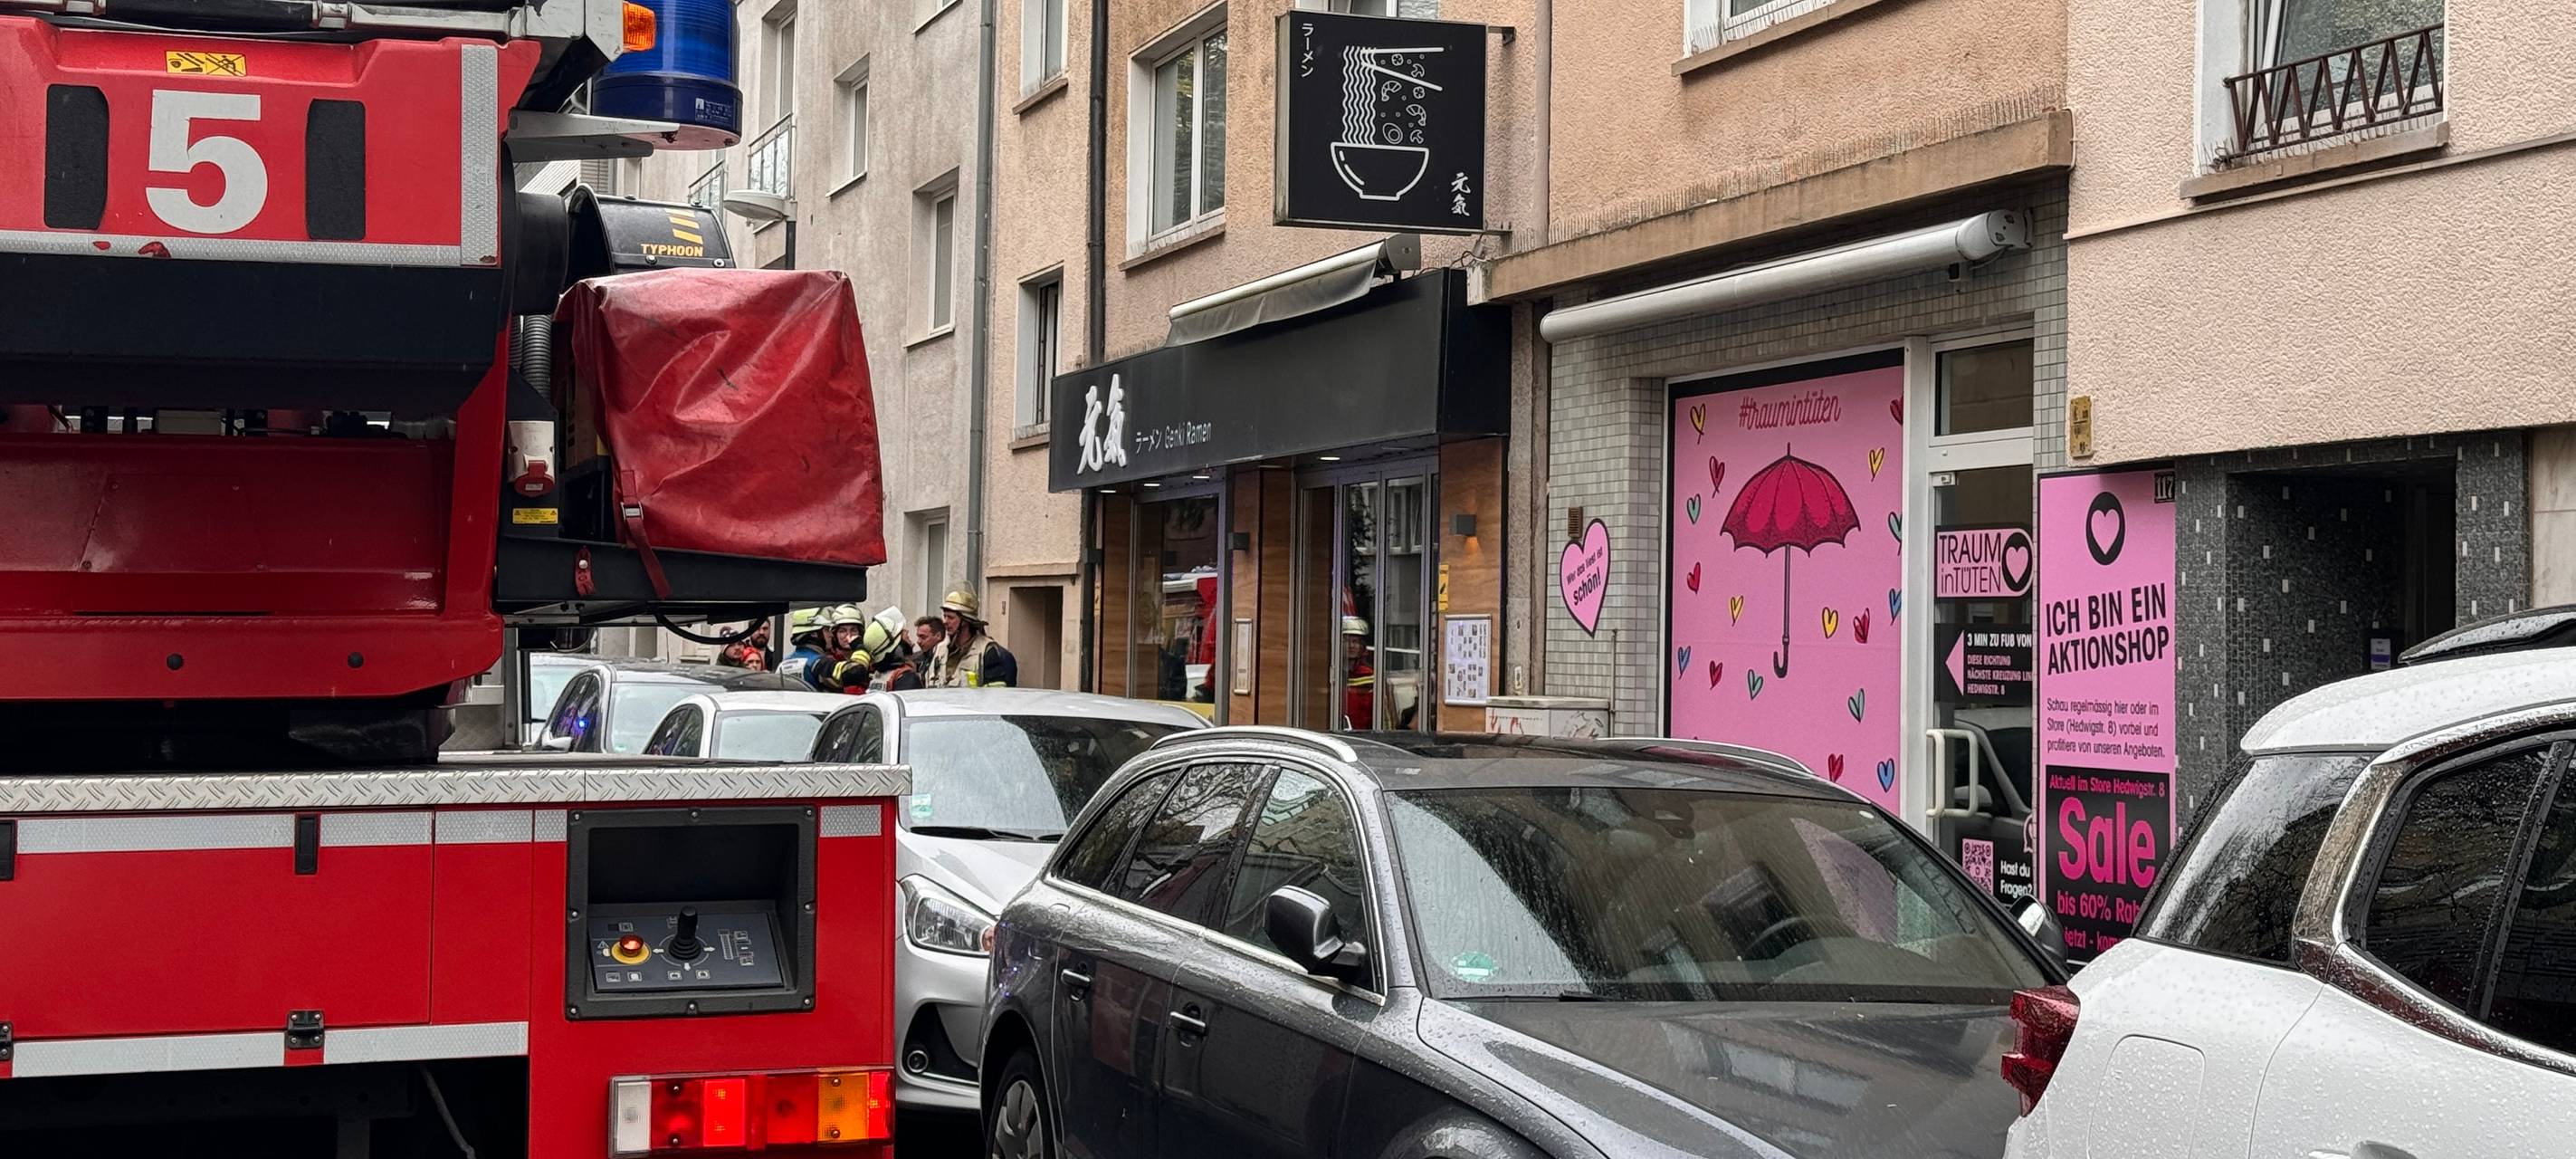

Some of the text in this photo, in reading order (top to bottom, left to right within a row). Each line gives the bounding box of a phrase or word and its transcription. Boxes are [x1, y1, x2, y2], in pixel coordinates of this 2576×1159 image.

[1301, 23, 1313, 78] ラーメン
[146, 89, 268, 234] 5
[640, 243, 704, 257] TYPHOON
[1739, 388, 1842, 430] #traumintüten
[1135, 420, 1212, 454] ラーメン Genki Ramen
[2157, 475, 2174, 500] 117
[1939, 532, 2001, 563] TRAUM
[1573, 566, 1601, 606] schön!
[1941, 566, 2001, 594] inTÜTEN
[2046, 582, 2166, 637] ICH BIN EIN
[1967, 633, 1972, 647] 3
[1974, 633, 1988, 647] MIN
[1989, 634, 1999, 647] ZU
[2017, 634, 2032, 647] VON
[2047, 626, 2170, 675] AKTIONSHOP
[1967, 654, 1982, 666] DIESE
[2046, 697, 2160, 717] Schau regelmässig hier oder im
[2046, 717, 2159, 737] Store (Hedwigstr. 8) vorbei und
[2077, 742, 2092, 753] von
[2093, 741, 2122, 755] unseren
[2123, 742, 2166, 760] Angeboten.
[2049, 774, 2165, 799] Aktuell im Store Hedwigstr. 8
[2058, 796, 2156, 888] Sale
[2000, 859, 2031, 877] Hast du
[2000, 879, 2033, 898] Fragen?
[2056, 889, 2076, 916] bis
[2079, 892, 2112, 921] 60%
